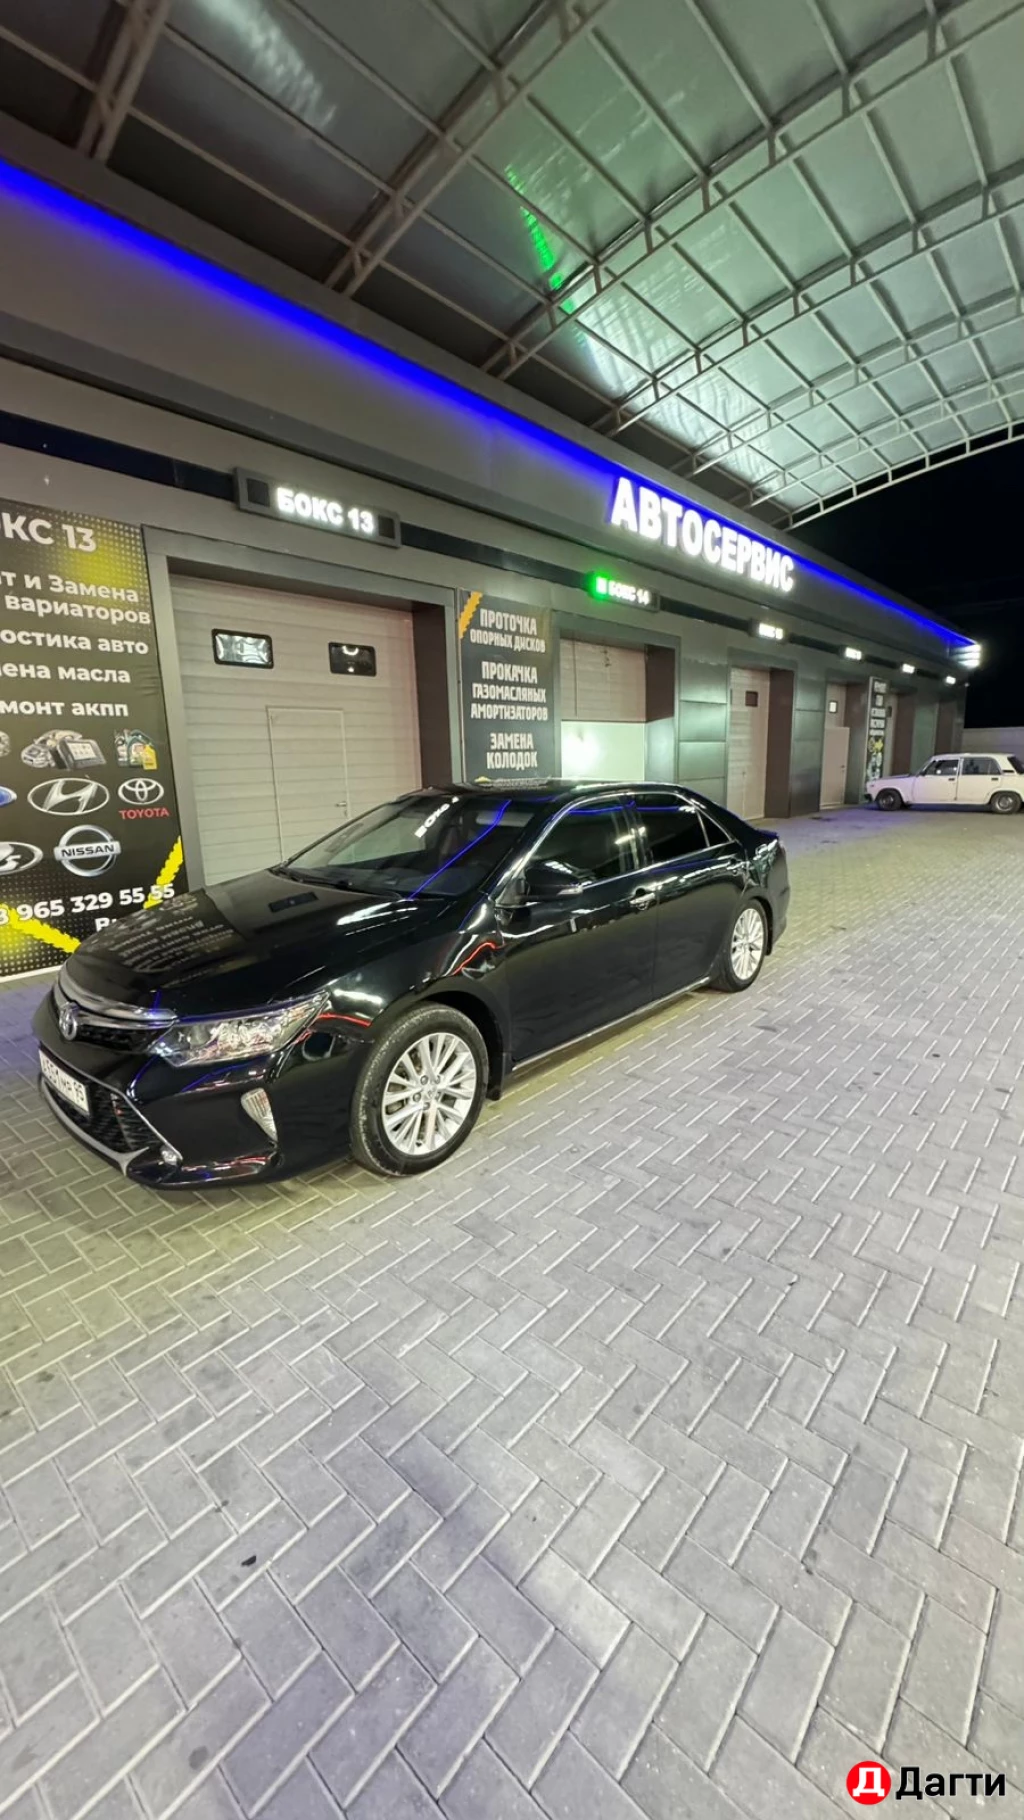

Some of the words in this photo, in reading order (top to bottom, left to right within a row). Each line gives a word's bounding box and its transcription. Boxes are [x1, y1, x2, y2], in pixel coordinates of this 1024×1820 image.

[276, 487, 344, 526] БОКС
[347, 507, 375, 535] 13
[0, 512, 54, 545] КС
[62, 524, 97, 553] 13
[610, 476, 794, 593] АВТОСЕРВИС
[24, 574, 42, 590] и
[48, 574, 139, 603] Замена
[4, 594, 151, 625] вариаторов
[479, 608, 537, 635] ПРОТОЧКА
[98, 637, 149, 655] авто
[470, 628, 513, 649] ОПОРНЫХ
[513, 635, 546, 653] ДИСКОВ
[0, 662, 51, 680] ена
[58, 666, 131, 684] масла
[481, 661, 538, 684] ПРОКАЧКА
[471, 683, 546, 703] ГАЗОМАСЛЯНЫХ
[71, 701, 129, 717] акпп
[470, 703, 548, 721] АМОРТИЗАТОРОВ
[490, 732, 534, 750] ЗАМЕНА
[486, 752, 538, 770] КОЛОДОК
[118, 807, 170, 820] TOYOTA
[61, 844, 115, 858] NISSAN
[16, 899, 64, 920] 965
[70, 892, 113, 913] 329
[119, 887, 146, 906] 55
[150, 883, 175, 899] 55
